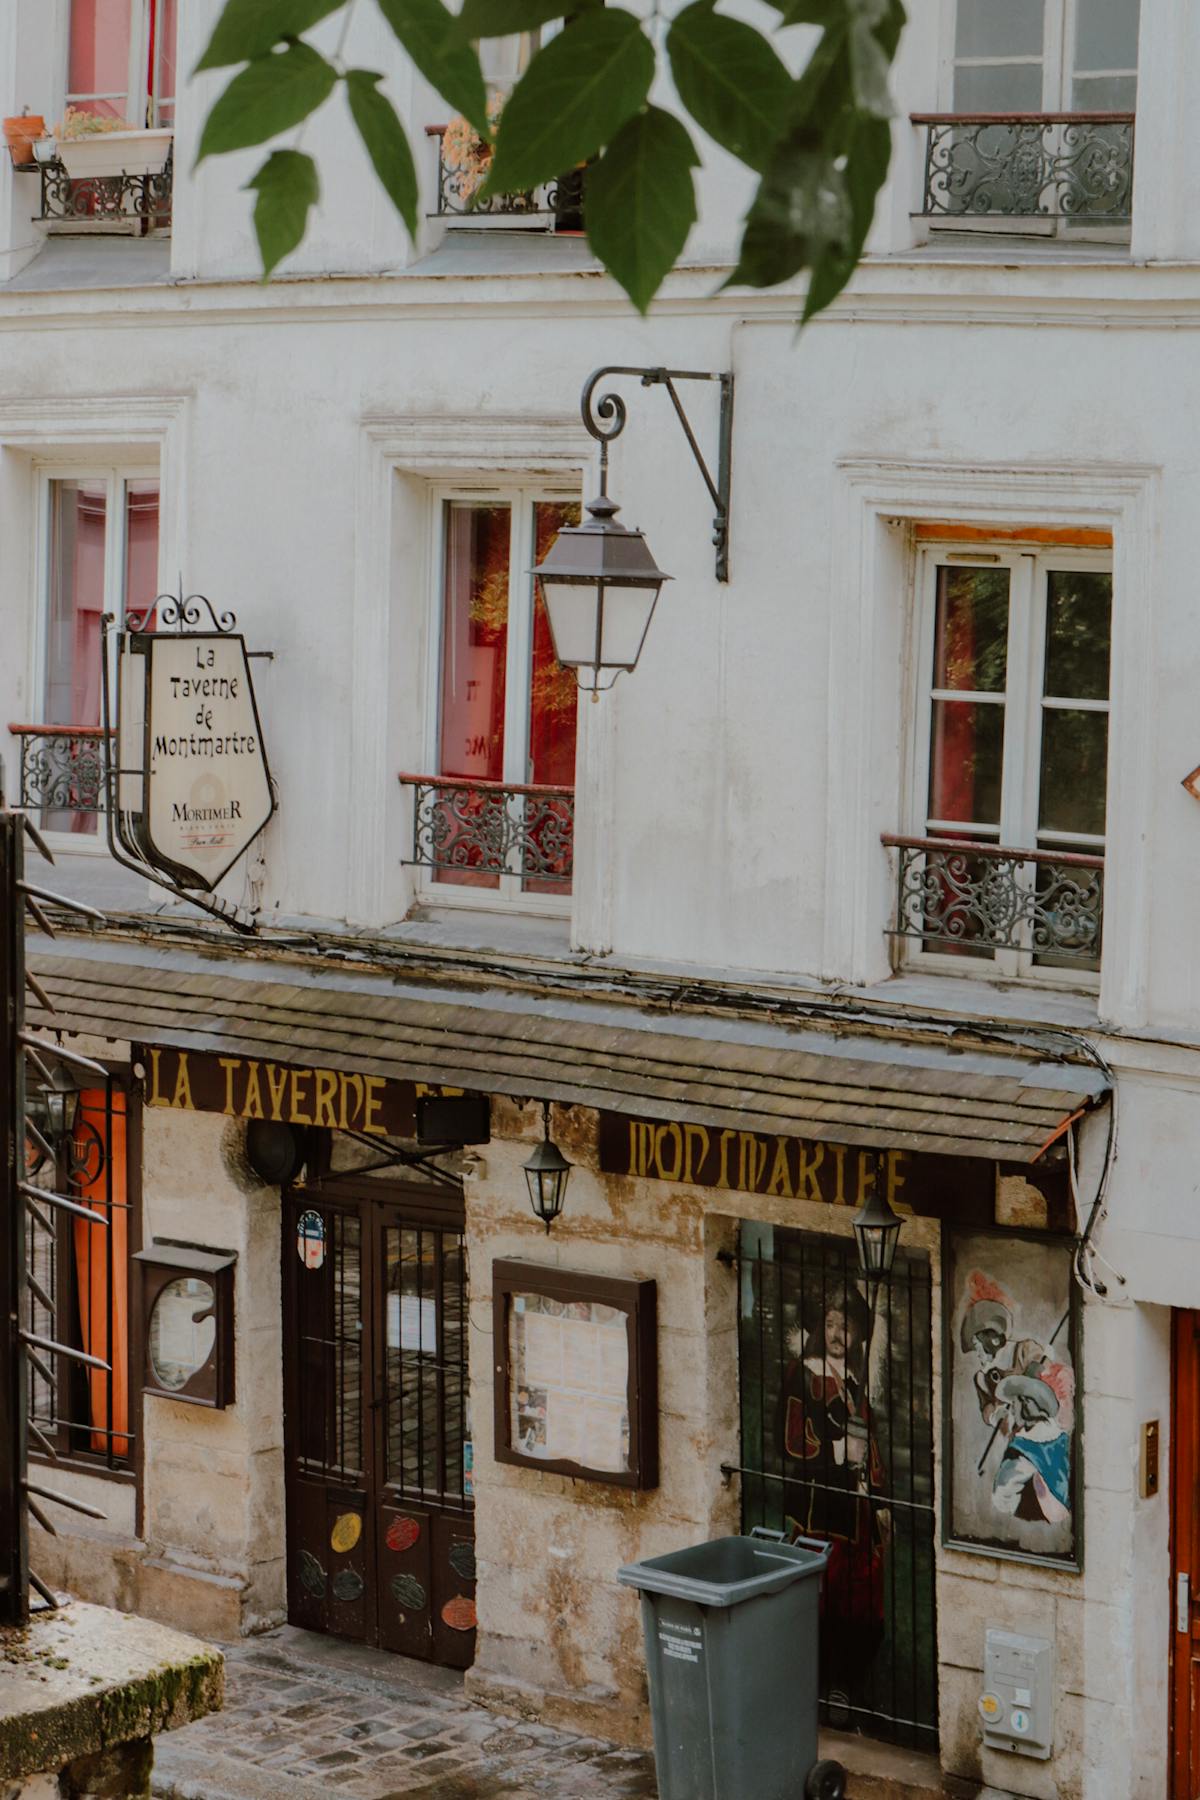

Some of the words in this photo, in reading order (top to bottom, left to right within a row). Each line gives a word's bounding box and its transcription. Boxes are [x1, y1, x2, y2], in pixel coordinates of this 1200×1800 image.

[196, 646, 215, 669] La
[170, 676, 239, 699] Taverne
[195, 703, 213, 730] de
[152, 732, 256, 760] Montmartre
[146, 1049, 195, 1109] LA
